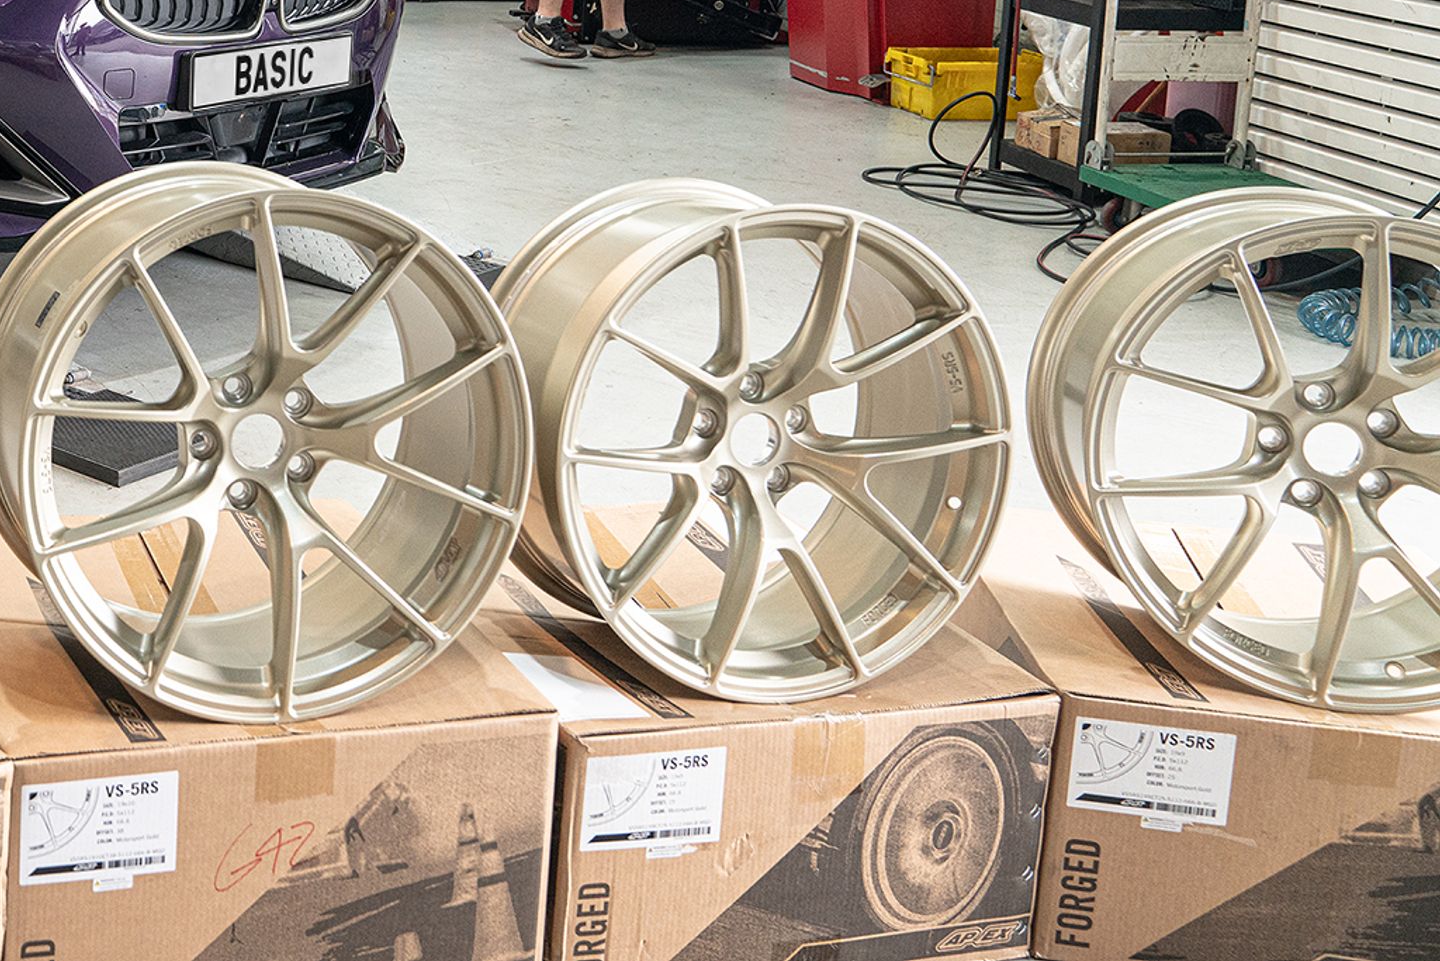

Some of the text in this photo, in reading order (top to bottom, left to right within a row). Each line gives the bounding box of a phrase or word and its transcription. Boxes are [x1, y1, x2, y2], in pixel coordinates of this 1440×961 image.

[235, 46, 314, 96] BASIC
[1160, 732, 1215, 751] VS-5RS
[661, 754, 709, 770] VS-5RS
[105, 781, 159, 798] VS-5RS
[1055, 839, 1101, 949] FORGED
[573, 882, 610, 961] RGED
[942, 924, 1017, 947] APEX
